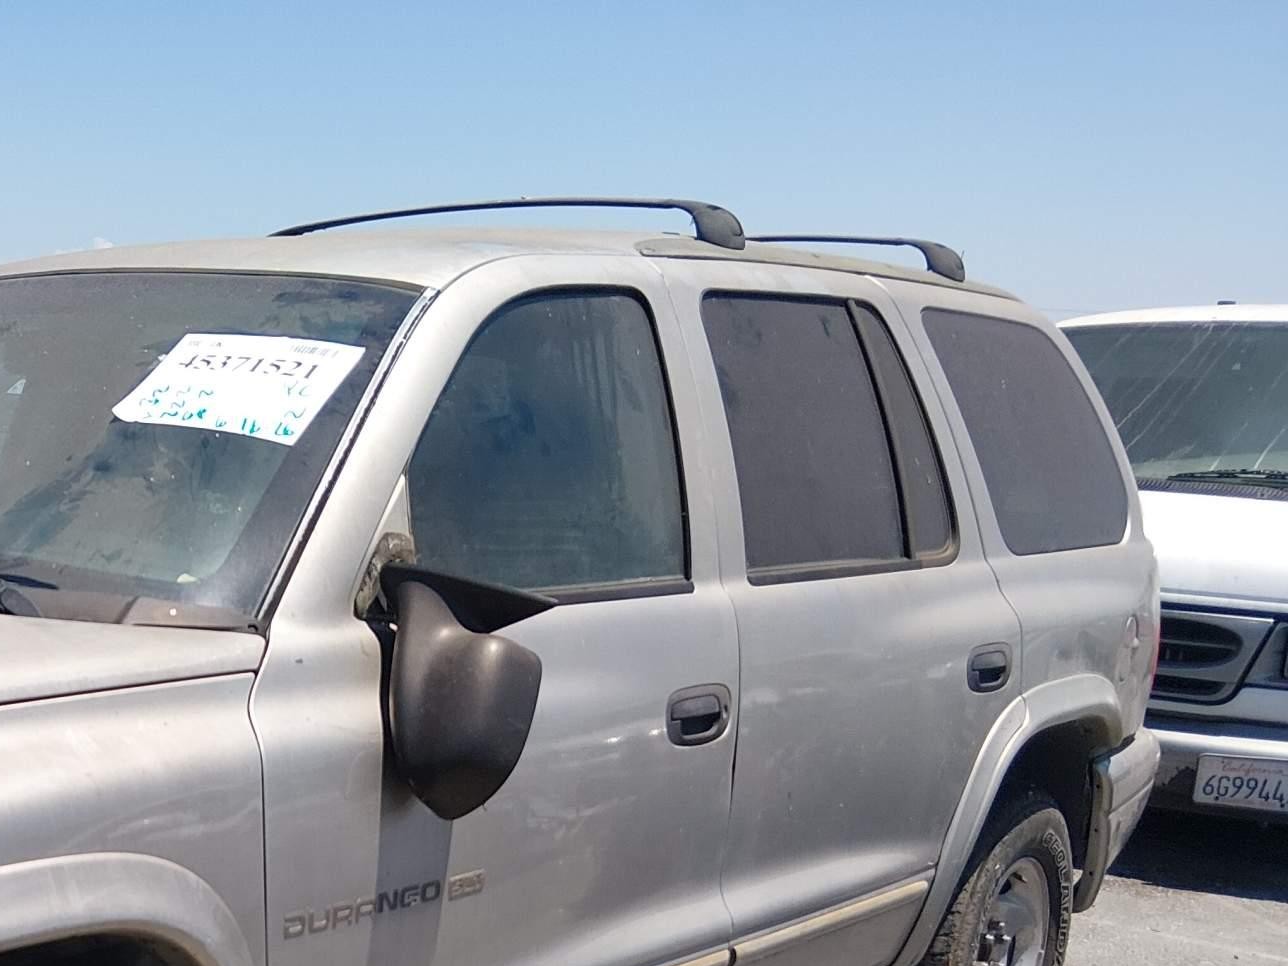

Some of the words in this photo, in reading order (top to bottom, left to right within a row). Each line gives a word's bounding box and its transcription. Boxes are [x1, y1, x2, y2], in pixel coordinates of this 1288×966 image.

[179, 353, 319, 380] 45371521
[1201, 774, 1288, 803] 6G9944
[283, 879, 441, 941] DURANGO
